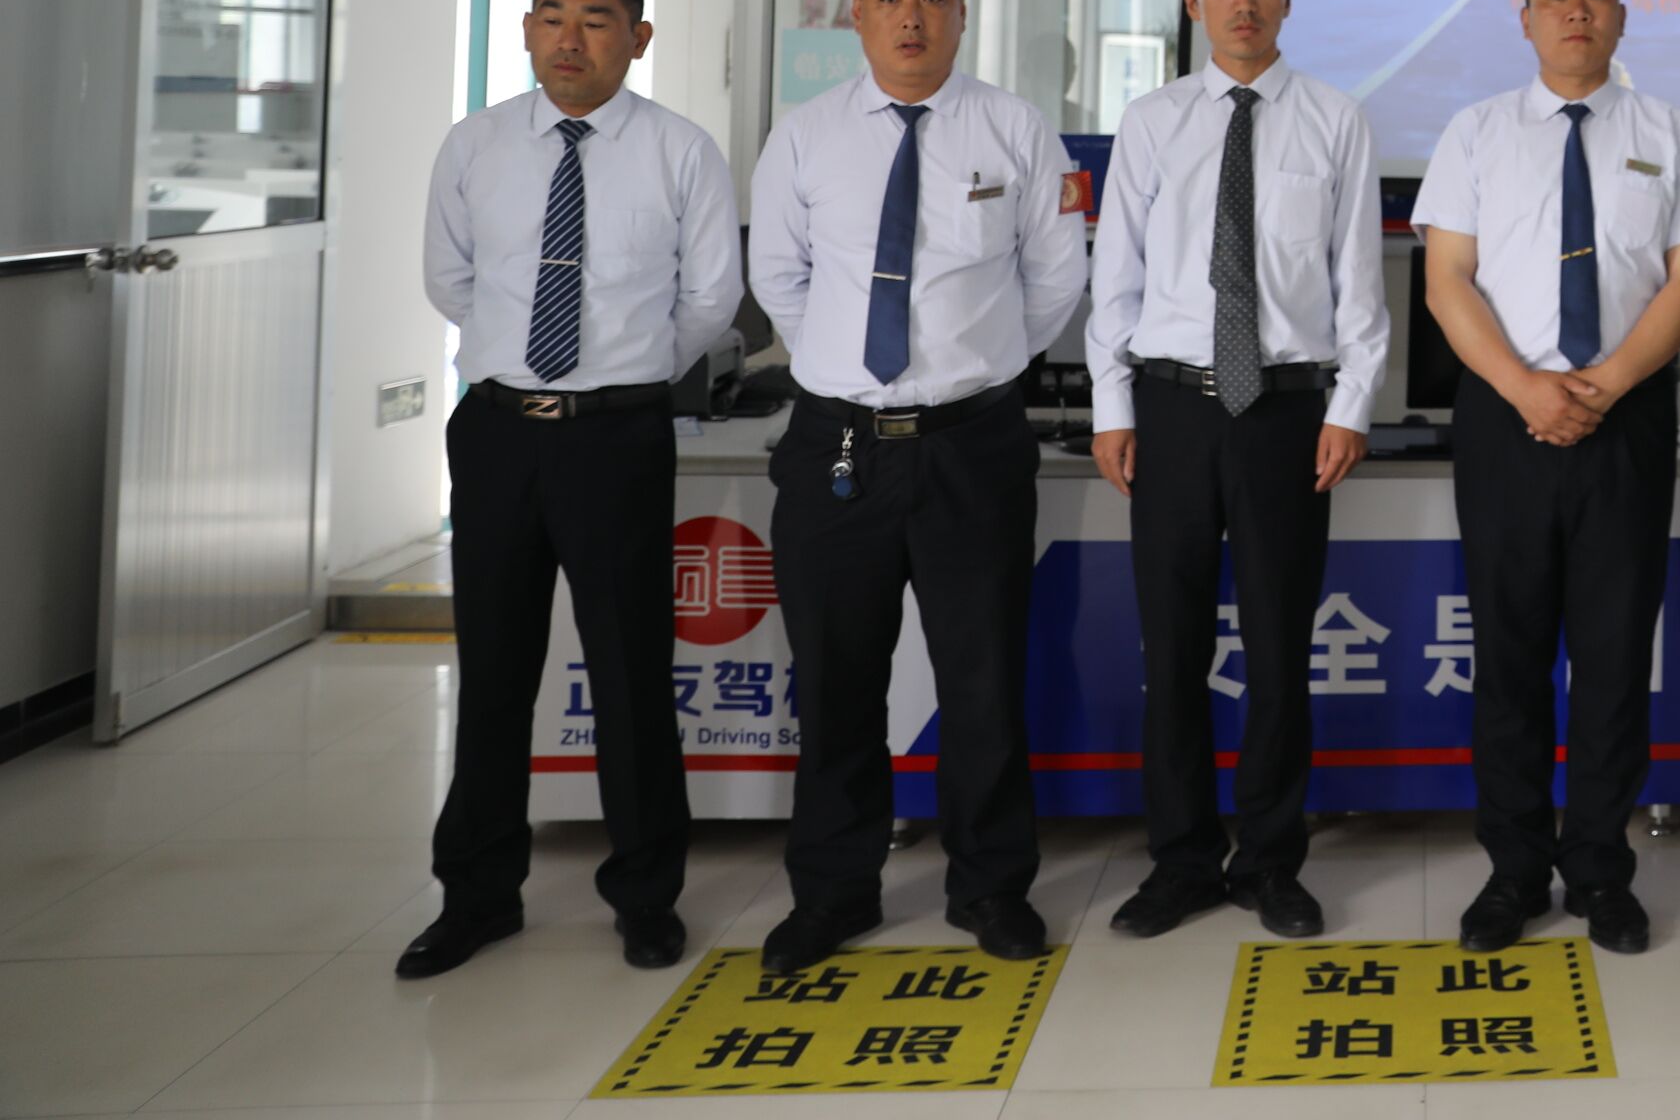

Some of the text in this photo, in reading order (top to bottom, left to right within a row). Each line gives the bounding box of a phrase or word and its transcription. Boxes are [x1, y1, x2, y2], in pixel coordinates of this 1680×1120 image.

[698, 728, 770, 749] Driving
[743, 965, 990, 1003] 站此
[1302, 958, 1531, 996] 站此
[695, 1025, 963, 1069] 拍照
[1296, 1016, 1538, 1059] 拍照
